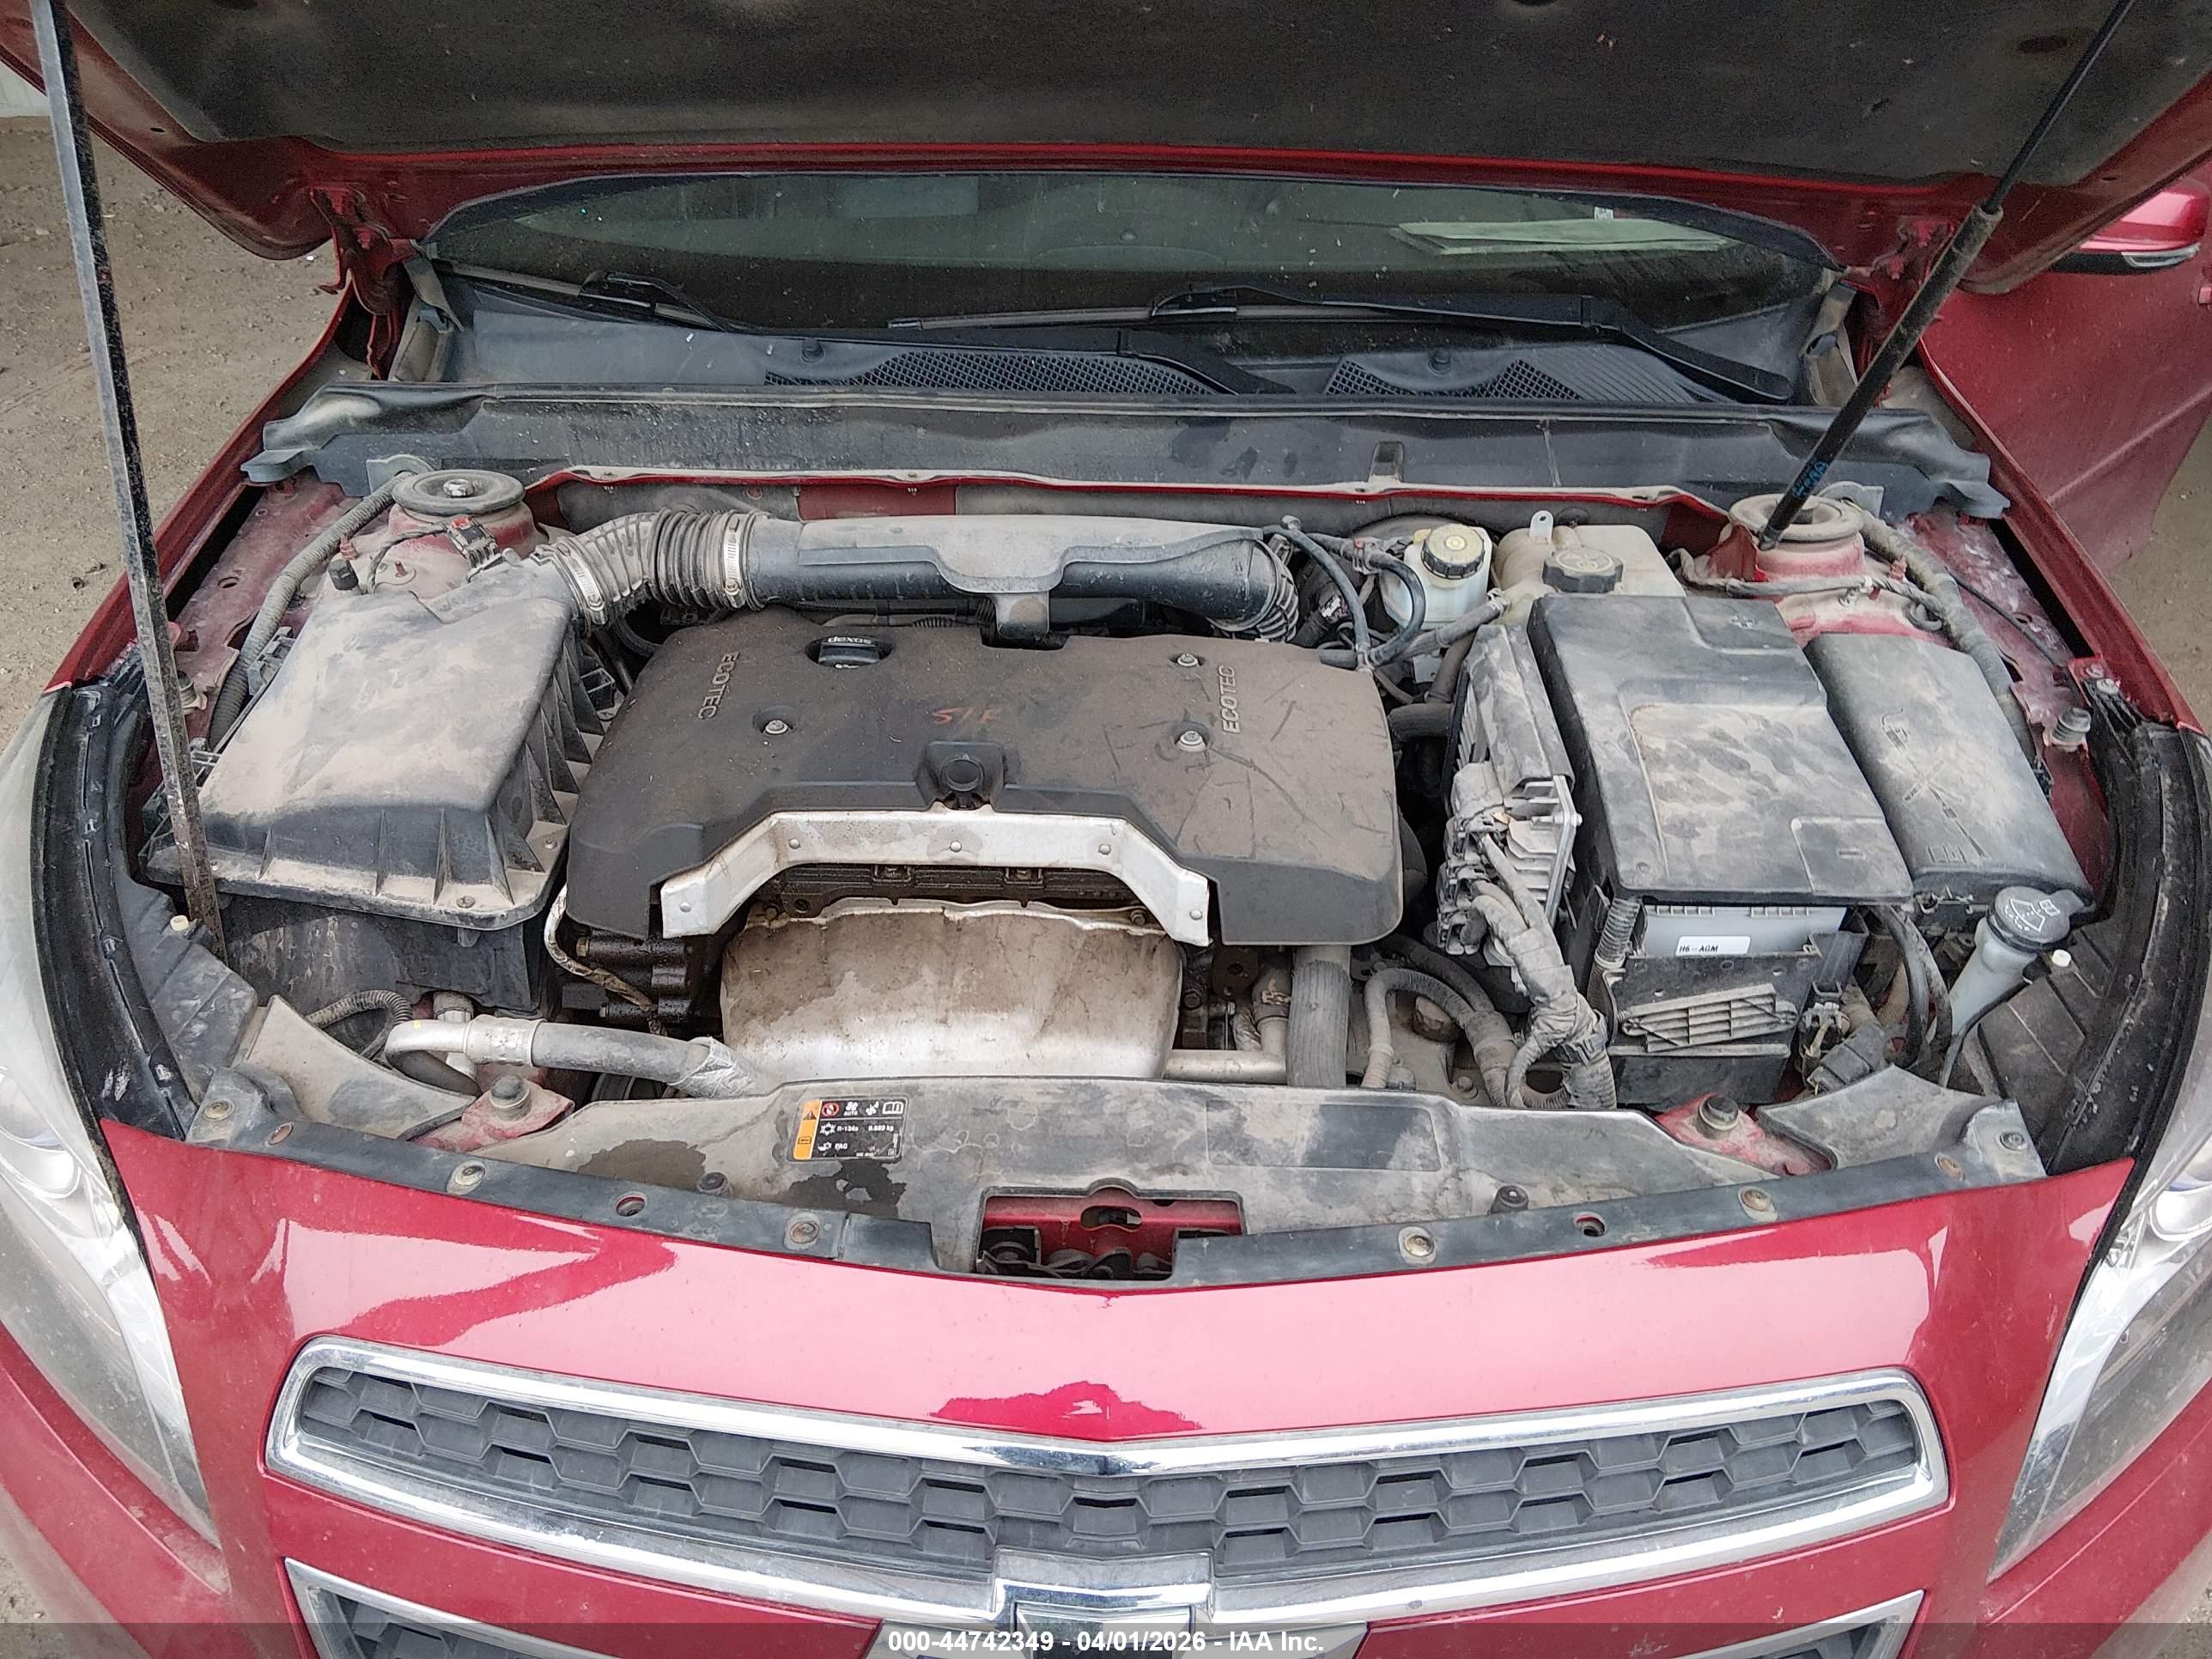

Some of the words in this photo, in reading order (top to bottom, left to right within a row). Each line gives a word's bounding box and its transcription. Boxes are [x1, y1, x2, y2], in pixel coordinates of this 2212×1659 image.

[828, 636, 872, 645] dexos
[698, 652, 740, 720] ECOTEC
[1218, 665, 1240, 734] ECOTEC
